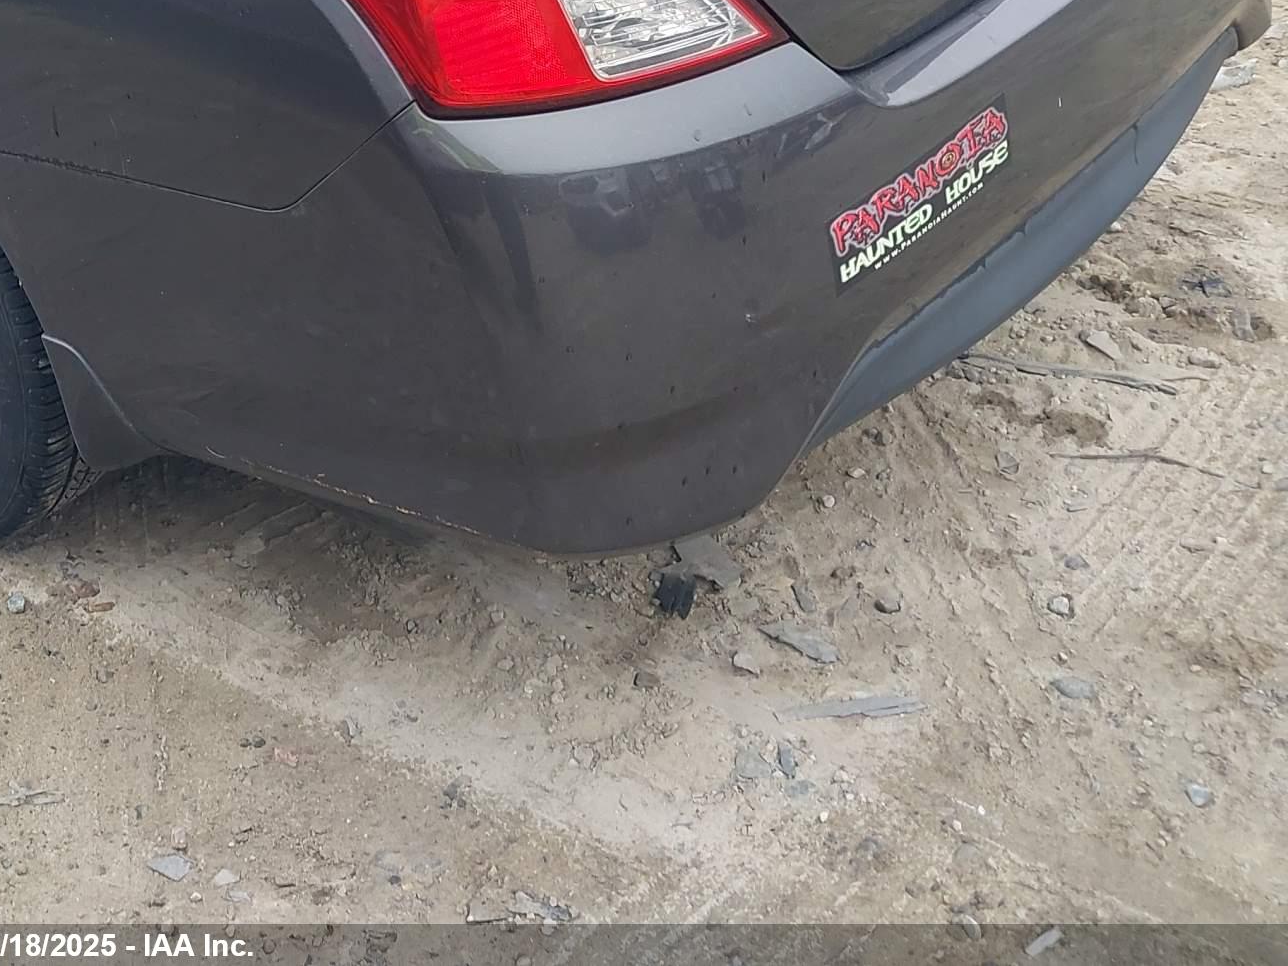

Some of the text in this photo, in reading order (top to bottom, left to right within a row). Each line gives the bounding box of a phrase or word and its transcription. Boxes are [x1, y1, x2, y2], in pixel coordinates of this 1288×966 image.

[830, 107, 1008, 257] PARANOIA
[839, 139, 1009, 283] HAUNTED HOUSE
